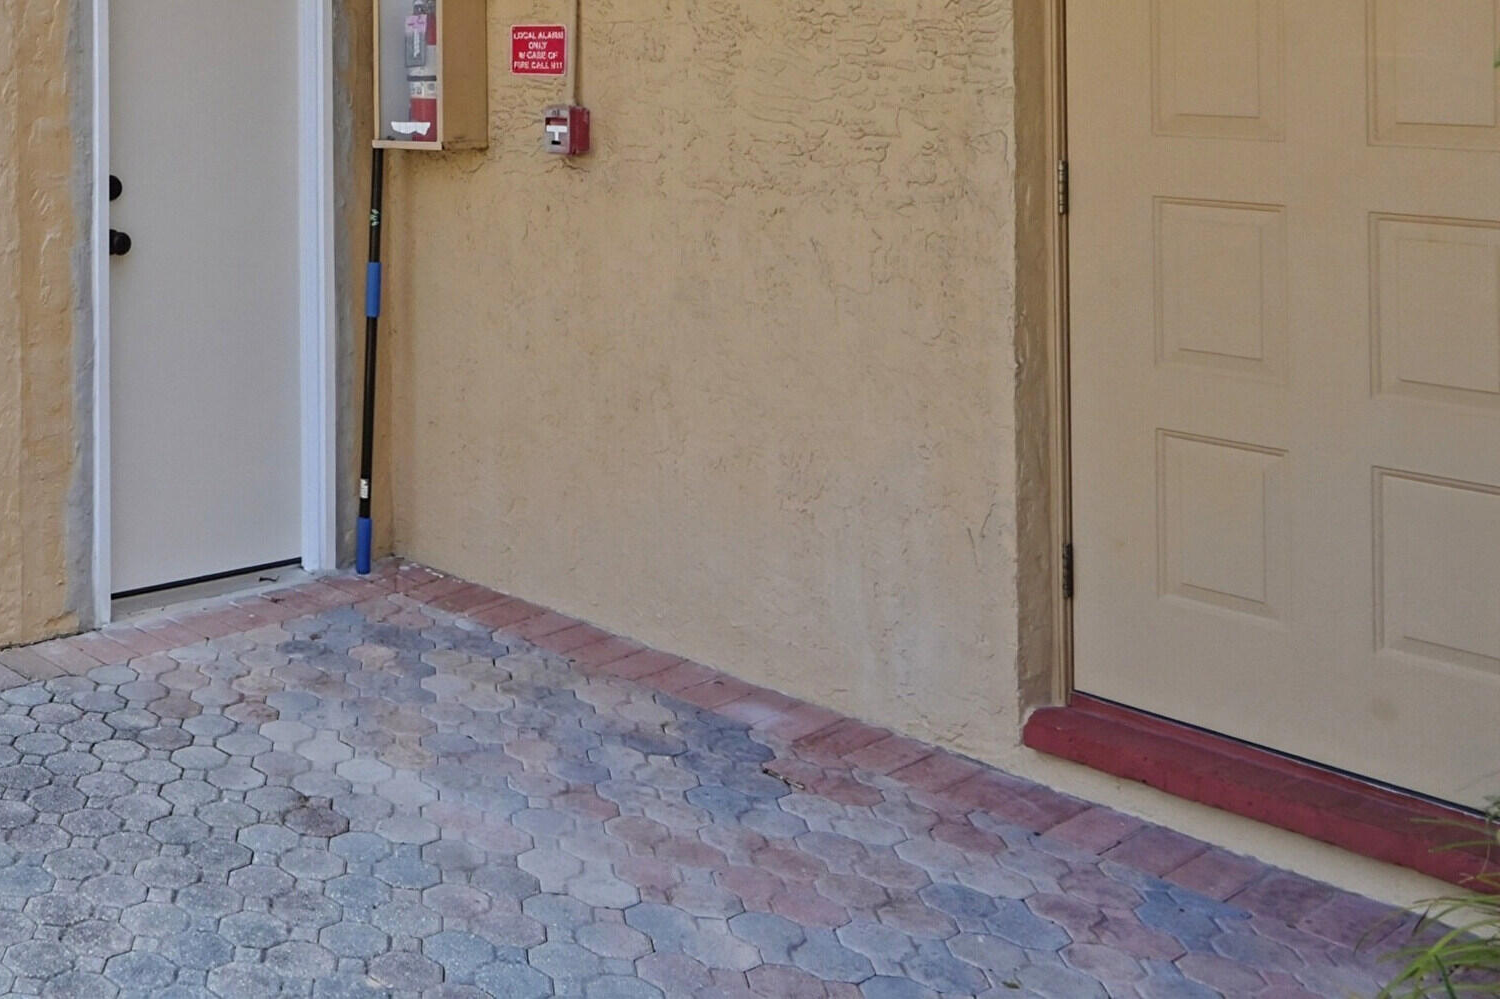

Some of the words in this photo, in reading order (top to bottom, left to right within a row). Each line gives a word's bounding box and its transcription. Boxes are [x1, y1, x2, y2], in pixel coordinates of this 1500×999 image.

[513, 31, 536, 40] LOCAL
[537, 31, 564, 39] ALARM
[528, 41, 548, 50] ONLY
[526, 51, 547, 60] CASE
[547, 51, 558, 60] OF
[513, 61, 530, 69] FIRE
[531, 61, 550, 70] CALL
